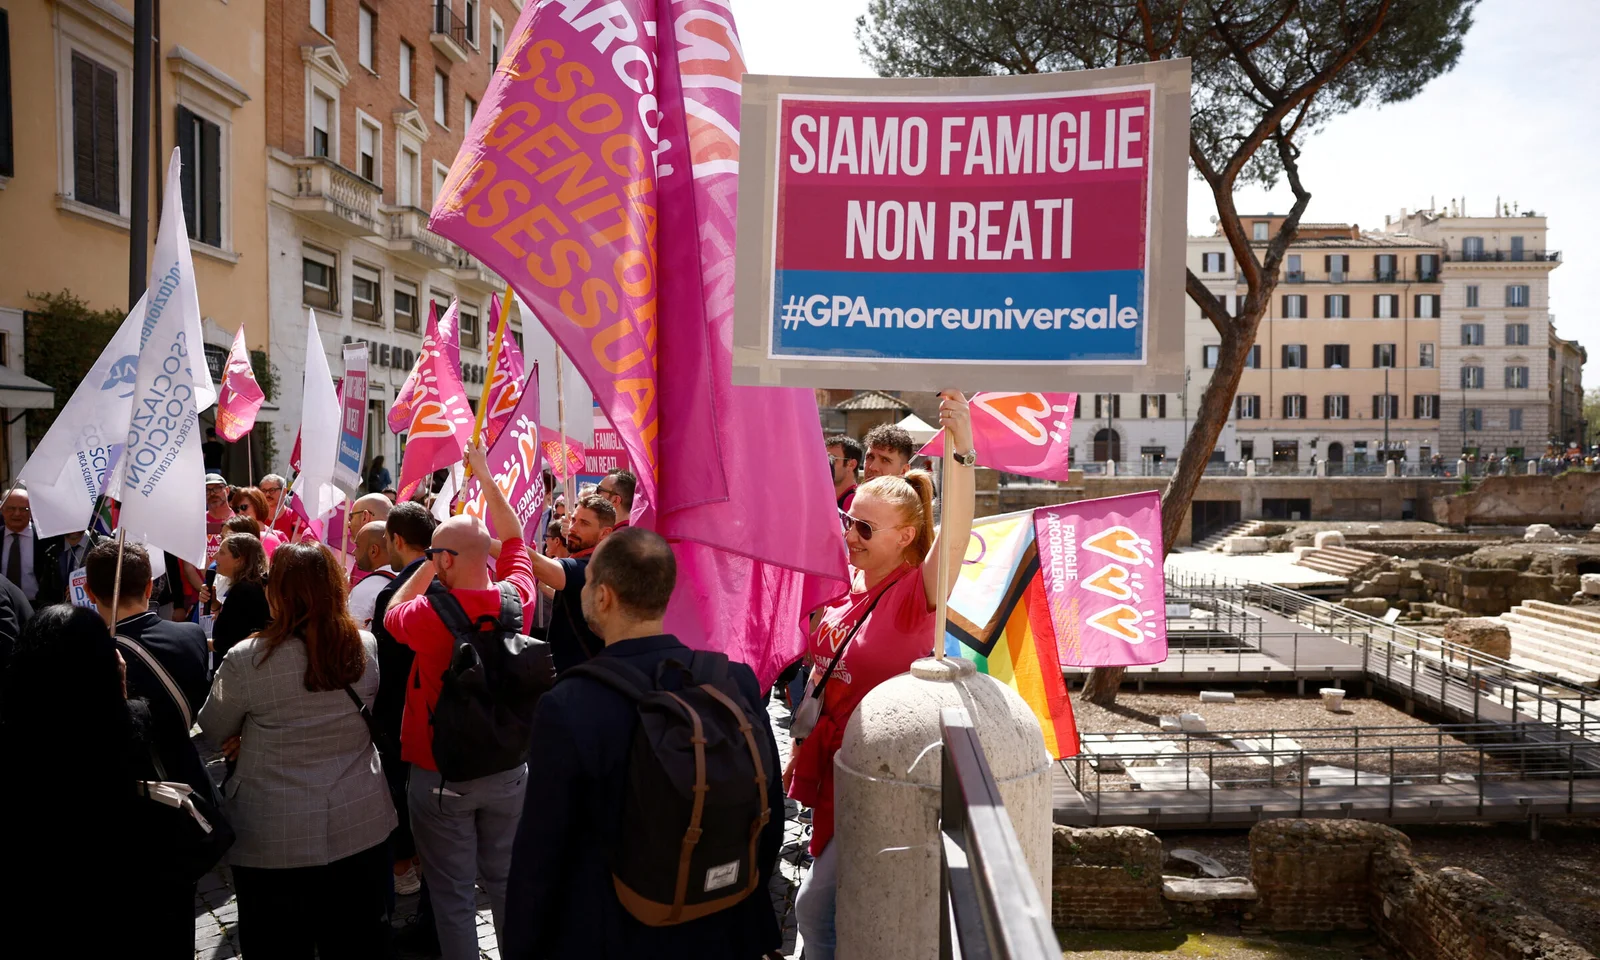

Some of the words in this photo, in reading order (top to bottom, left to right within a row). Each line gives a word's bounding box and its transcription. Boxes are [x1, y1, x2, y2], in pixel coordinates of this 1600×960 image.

[500, 28, 657, 264] SSOCIA
[789, 114, 928, 176] SIAMO
[940, 106, 1145, 176] FAMIGLIE
[483, 102, 657, 371] GENITOR
[845, 200, 936, 261] NON
[947, 198, 1074, 261] REATI
[440, 155, 658, 484] OSESSUAL
[781, 294, 1138, 331] #GPAmoreuniversale
[594, 432, 625, 450] FAMIGL
[1378, 440, 1404, 449] PZZA
[1047, 511, 1065, 593] ARCOBALENO
[1062, 524, 1078, 581] FAMIGLIE
